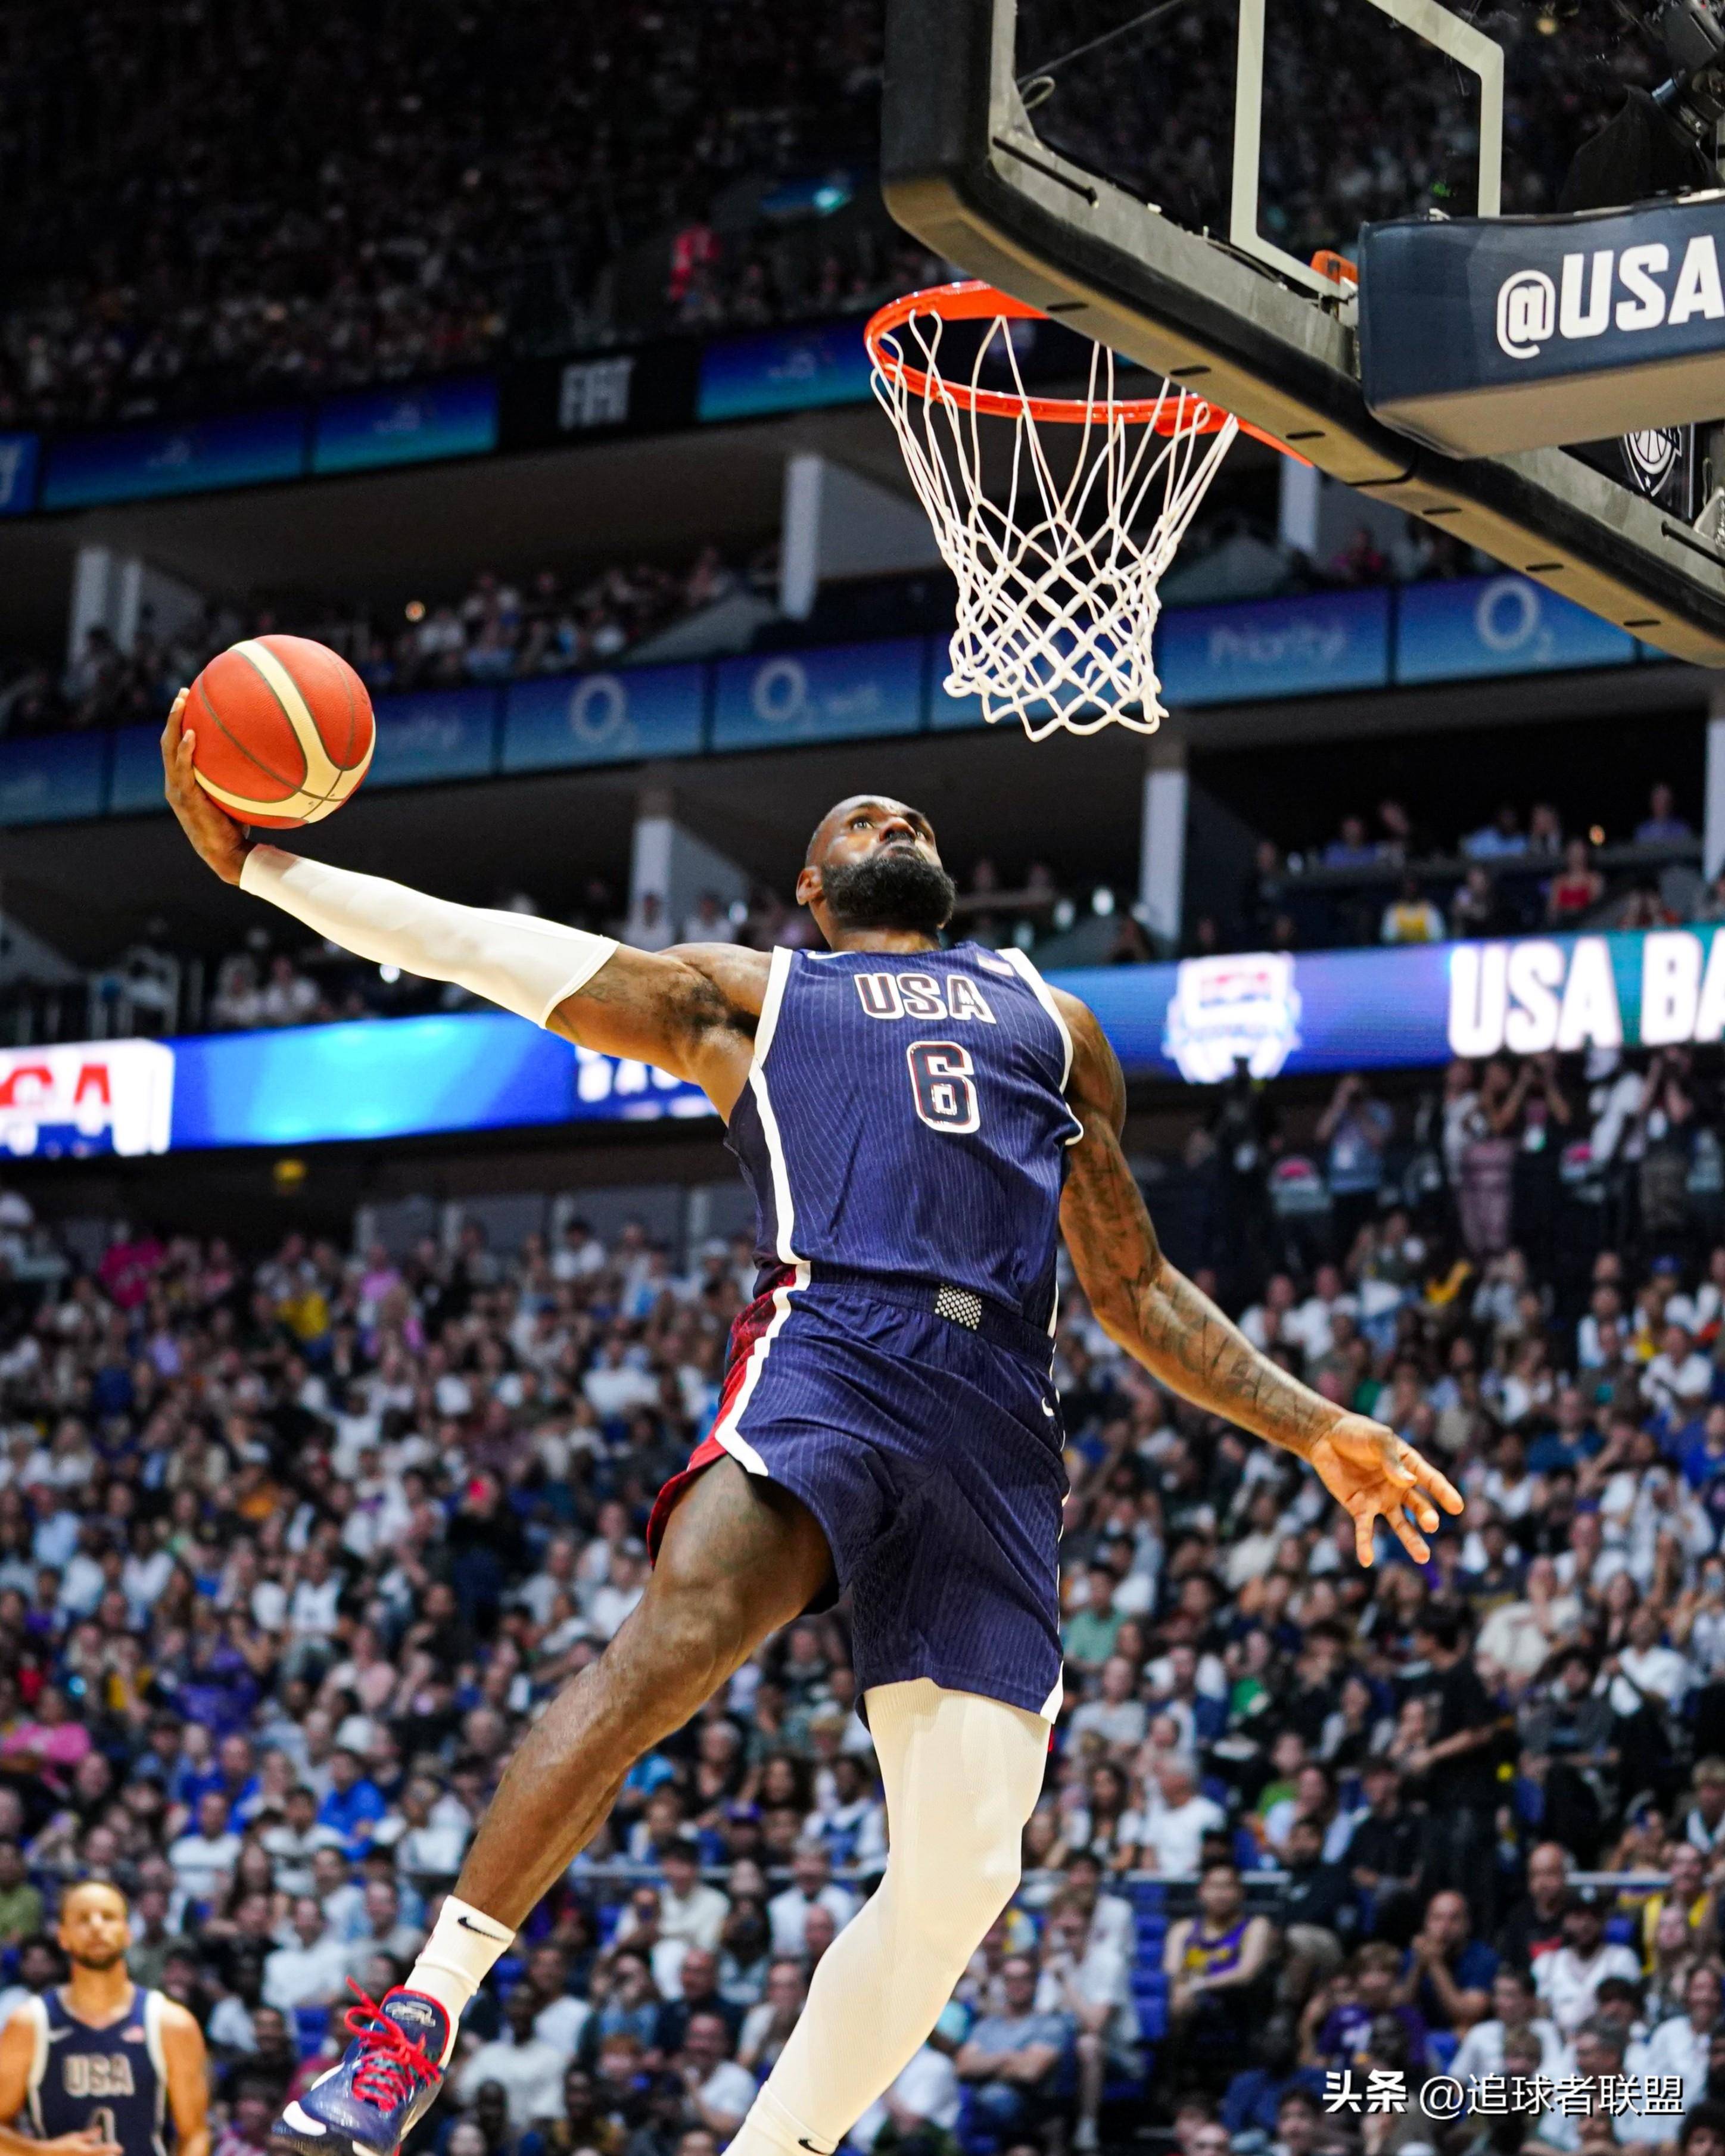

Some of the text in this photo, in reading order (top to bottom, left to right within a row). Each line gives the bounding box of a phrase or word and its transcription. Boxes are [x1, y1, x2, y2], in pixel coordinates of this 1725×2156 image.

[1496, 234, 1725, 360] @USA
[854, 972, 997, 1024] USA
[1447, 935, 1623, 1058] USA
[906, 1040, 980, 1134] 6
[63, 2052, 136, 2098] USA
